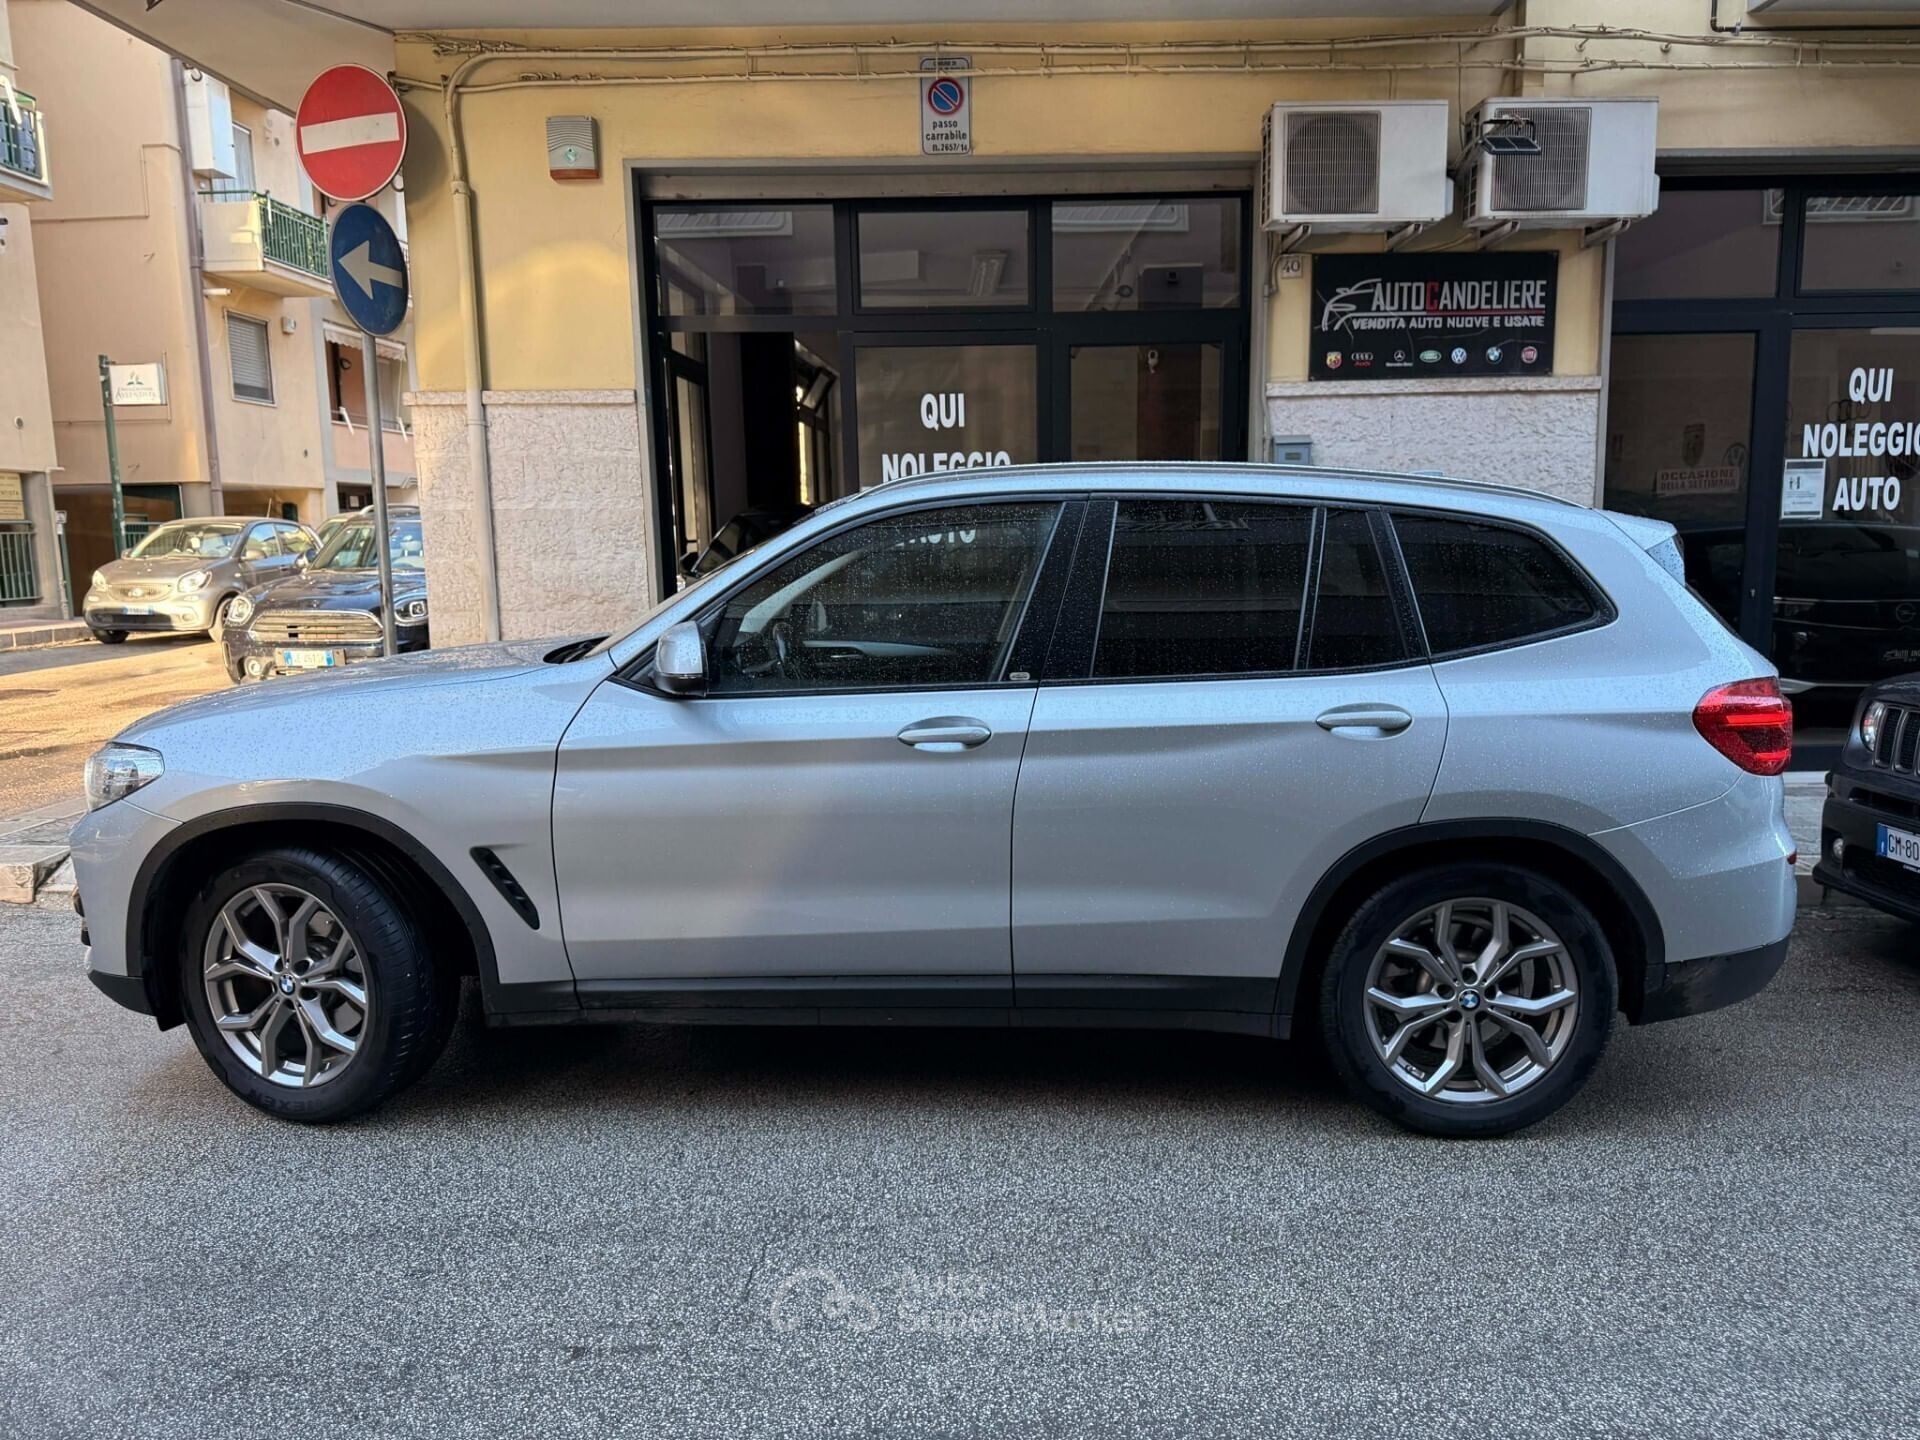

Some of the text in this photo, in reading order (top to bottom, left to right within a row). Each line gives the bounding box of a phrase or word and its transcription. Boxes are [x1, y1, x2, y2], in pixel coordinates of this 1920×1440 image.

[925, 130, 967, 141] carrabile
[932, 120, 958, 130] passo
[1282, 260, 1300, 273] 40
[1371, 280, 1547, 312] AUTOCANDELIERE
[1352, 315, 1545, 330] VENDITA AUTO NUOVE E USATE
[1849, 367, 1894, 404] QUI
[920, 393, 965, 431] QUI
[1832, 476, 1901, 511] AUTO
